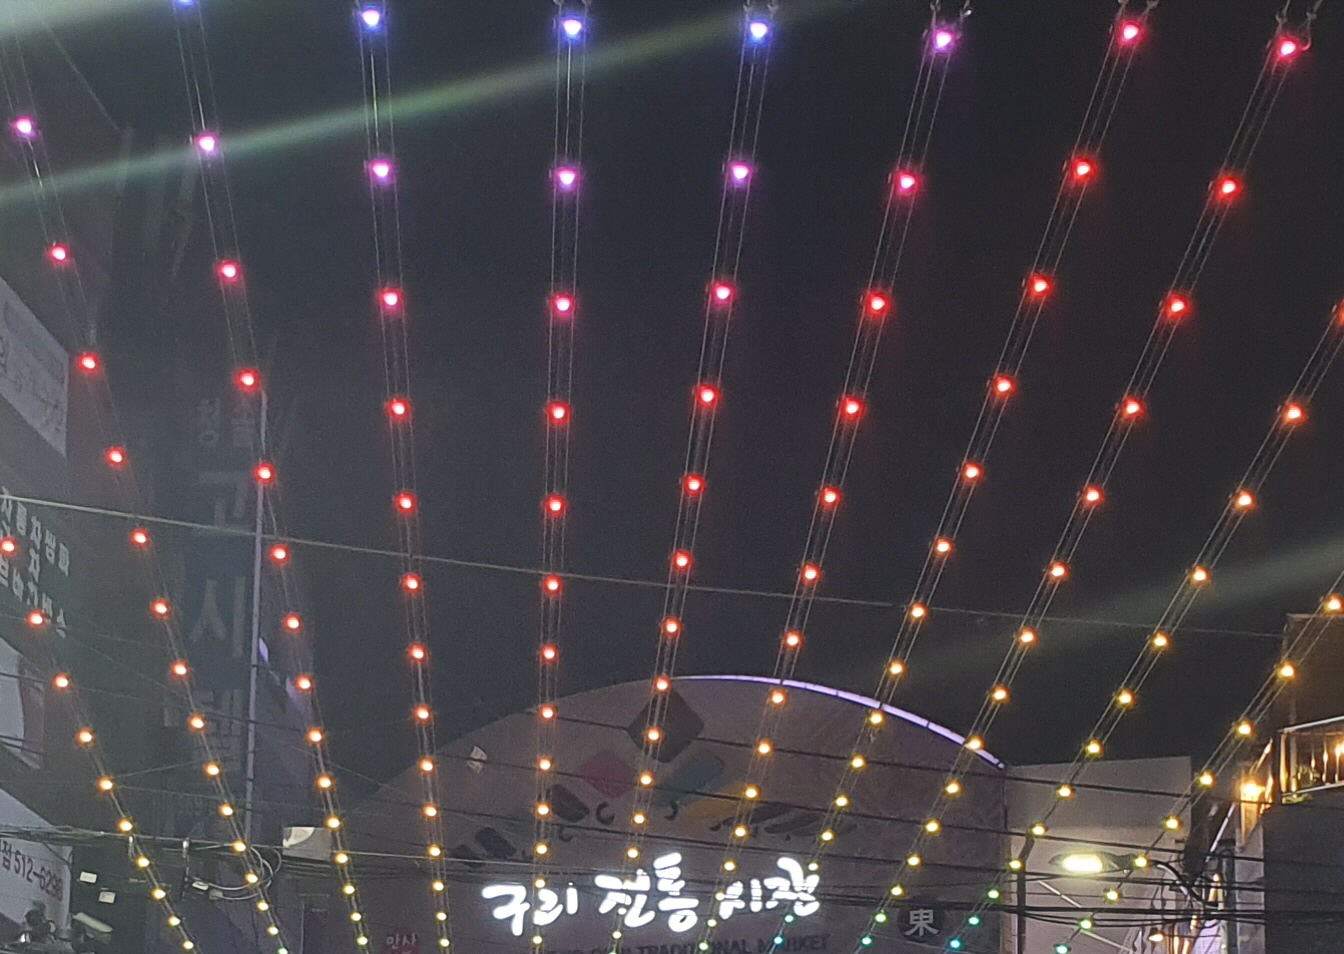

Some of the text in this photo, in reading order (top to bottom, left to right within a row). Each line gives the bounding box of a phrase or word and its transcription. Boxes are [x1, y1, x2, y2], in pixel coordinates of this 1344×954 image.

[481, 852, 821, 935] 구리 전통 시장
[904, 909, 940, 937] 東
